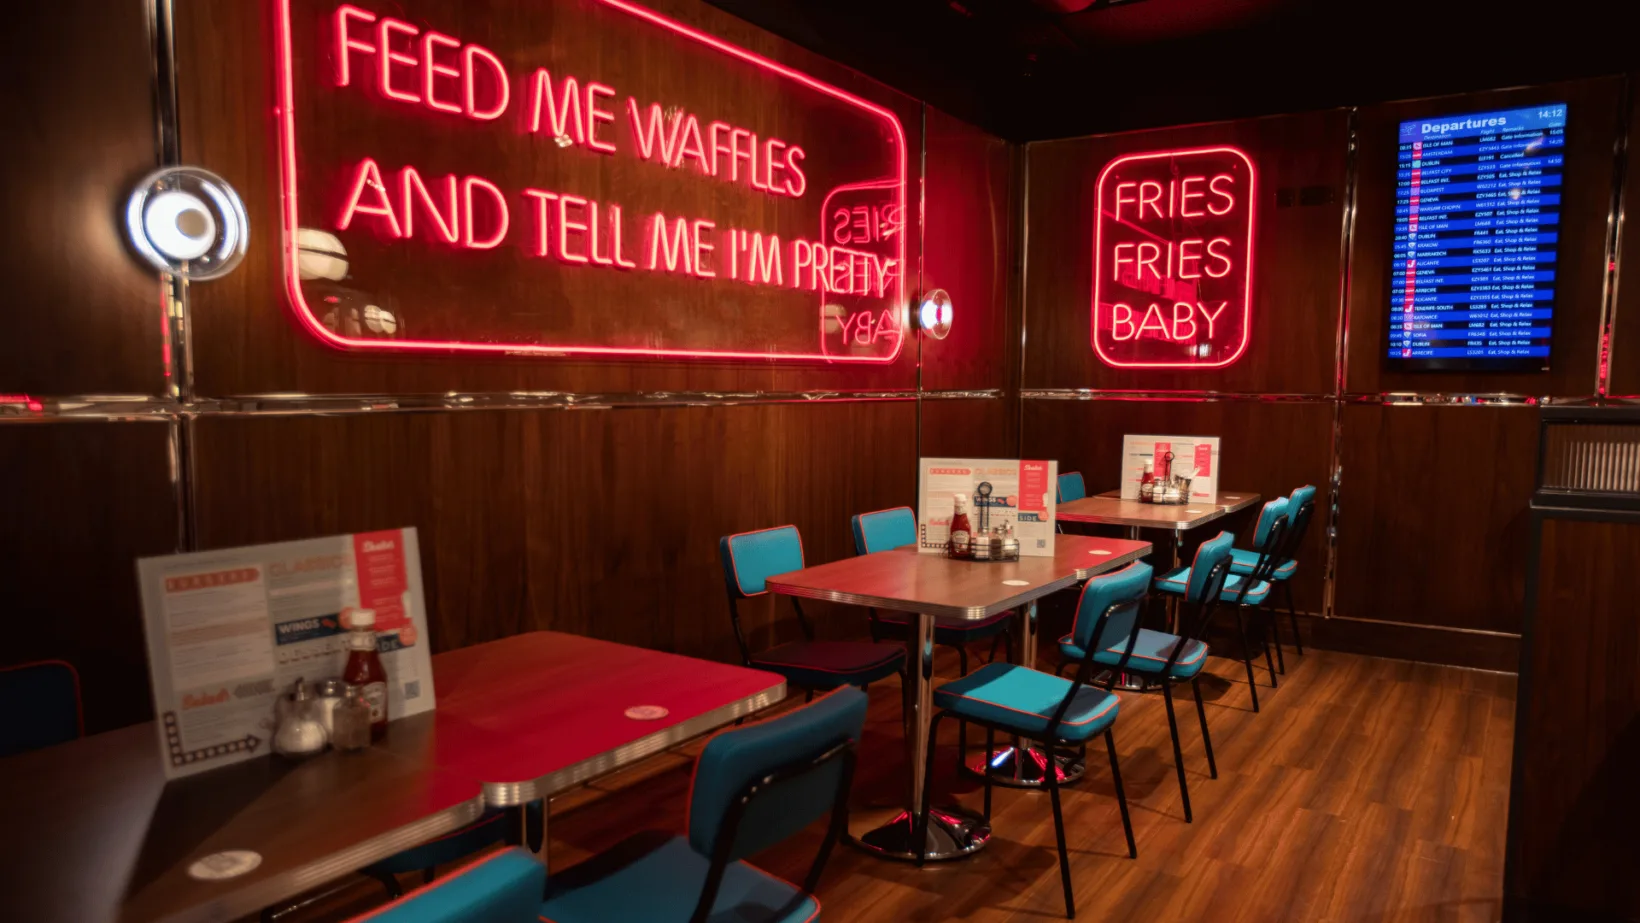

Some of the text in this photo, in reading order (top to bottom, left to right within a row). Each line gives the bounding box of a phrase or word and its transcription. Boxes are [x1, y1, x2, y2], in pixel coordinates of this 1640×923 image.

[335, 4, 806, 197] FEED ME WAFFLES
[1537, 109, 1562, 118] 14:12
[1421, 114, 1506, 135] Departures
[1500, 151, 1524, 159] Cancelled
[1115, 175, 1234, 221] FRIES
[336, 157, 896, 298] AND TELL ME I'M PRETTY
[1113, 238, 1231, 281] FRIES
[1112, 302, 1227, 341] BABY
[278, 620, 320, 635] WINGS
